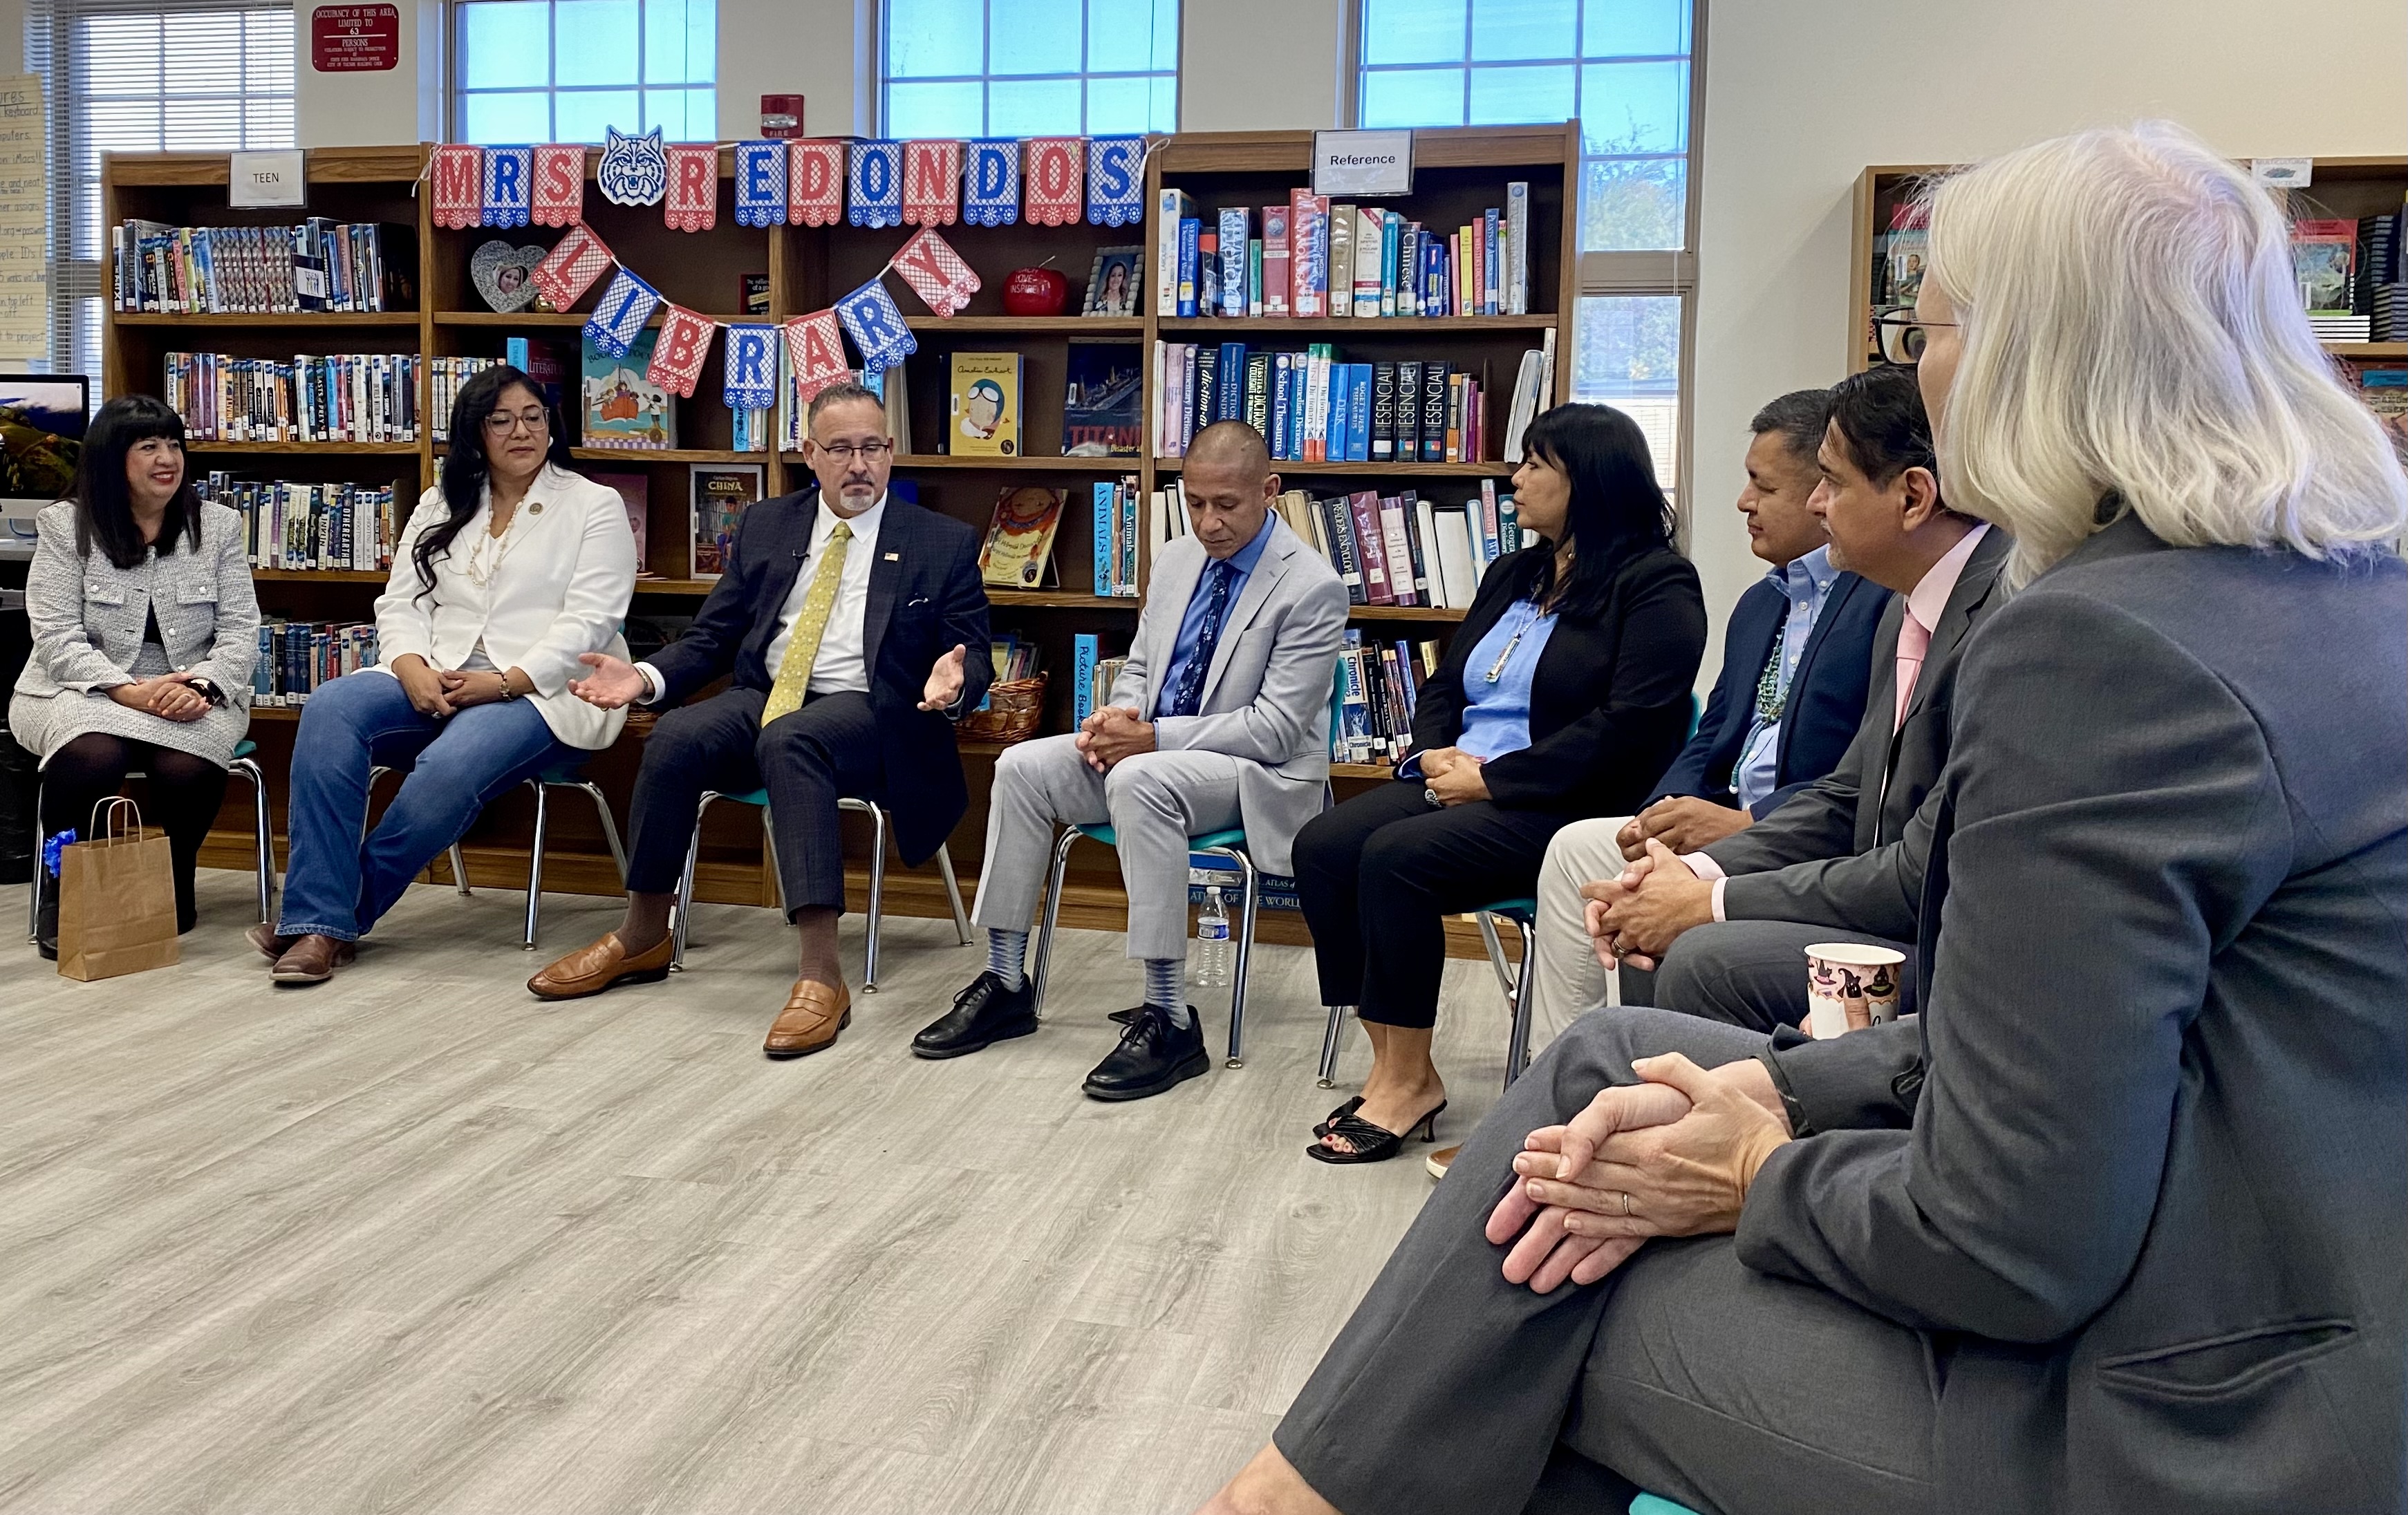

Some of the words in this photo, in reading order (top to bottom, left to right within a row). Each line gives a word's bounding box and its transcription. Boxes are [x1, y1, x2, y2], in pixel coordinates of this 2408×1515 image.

[316, 9, 350, 18] OCCUPANCY
[363, 8, 376, 17] THIS
[380, 8, 395, 16] AREA
[338, 19, 362, 28] LIMITED
[365, 18, 373, 27] TO
[350, 27, 359, 35] 63
[342, 39, 368, 47] PERSONS
[253, 173, 279, 183] TEEN
[440, 153, 572, 205] MRS
[680, 146, 1130, 206] REDONDOS
[1330, 155, 1396, 165] Reference
[1401, 233, 1416, 287] Chinese
[556, 239, 952, 385] LIBRARY
[1183, 361, 1194, 406] Elementary
[1276, 370, 1287, 401] School
[1295, 369, 1305, 416] Intermediate
[1307, 385, 1316, 425] Dictionary
[1318, 386, 1327, 426] Dictionary
[1181, 406, 1193, 449] Dictionary
[1275, 402, 1286, 451] Thesaurus
[1292, 417, 1303, 456] Dictionary
[1110, 444, 1135, 453] Disaster
[708, 481, 743, 491] CHINA
[1098, 487, 1108, 553] ANIMALS
[1126, 514, 1135, 552] Animals
[1079, 646, 1088, 689] Picture
[1348, 657, 1361, 697] Chronicle
[1224, 894, 1239, 903] OF
[1265, 879, 1289, 888] ATLAS
[1289, 881, 1296, 890] of
